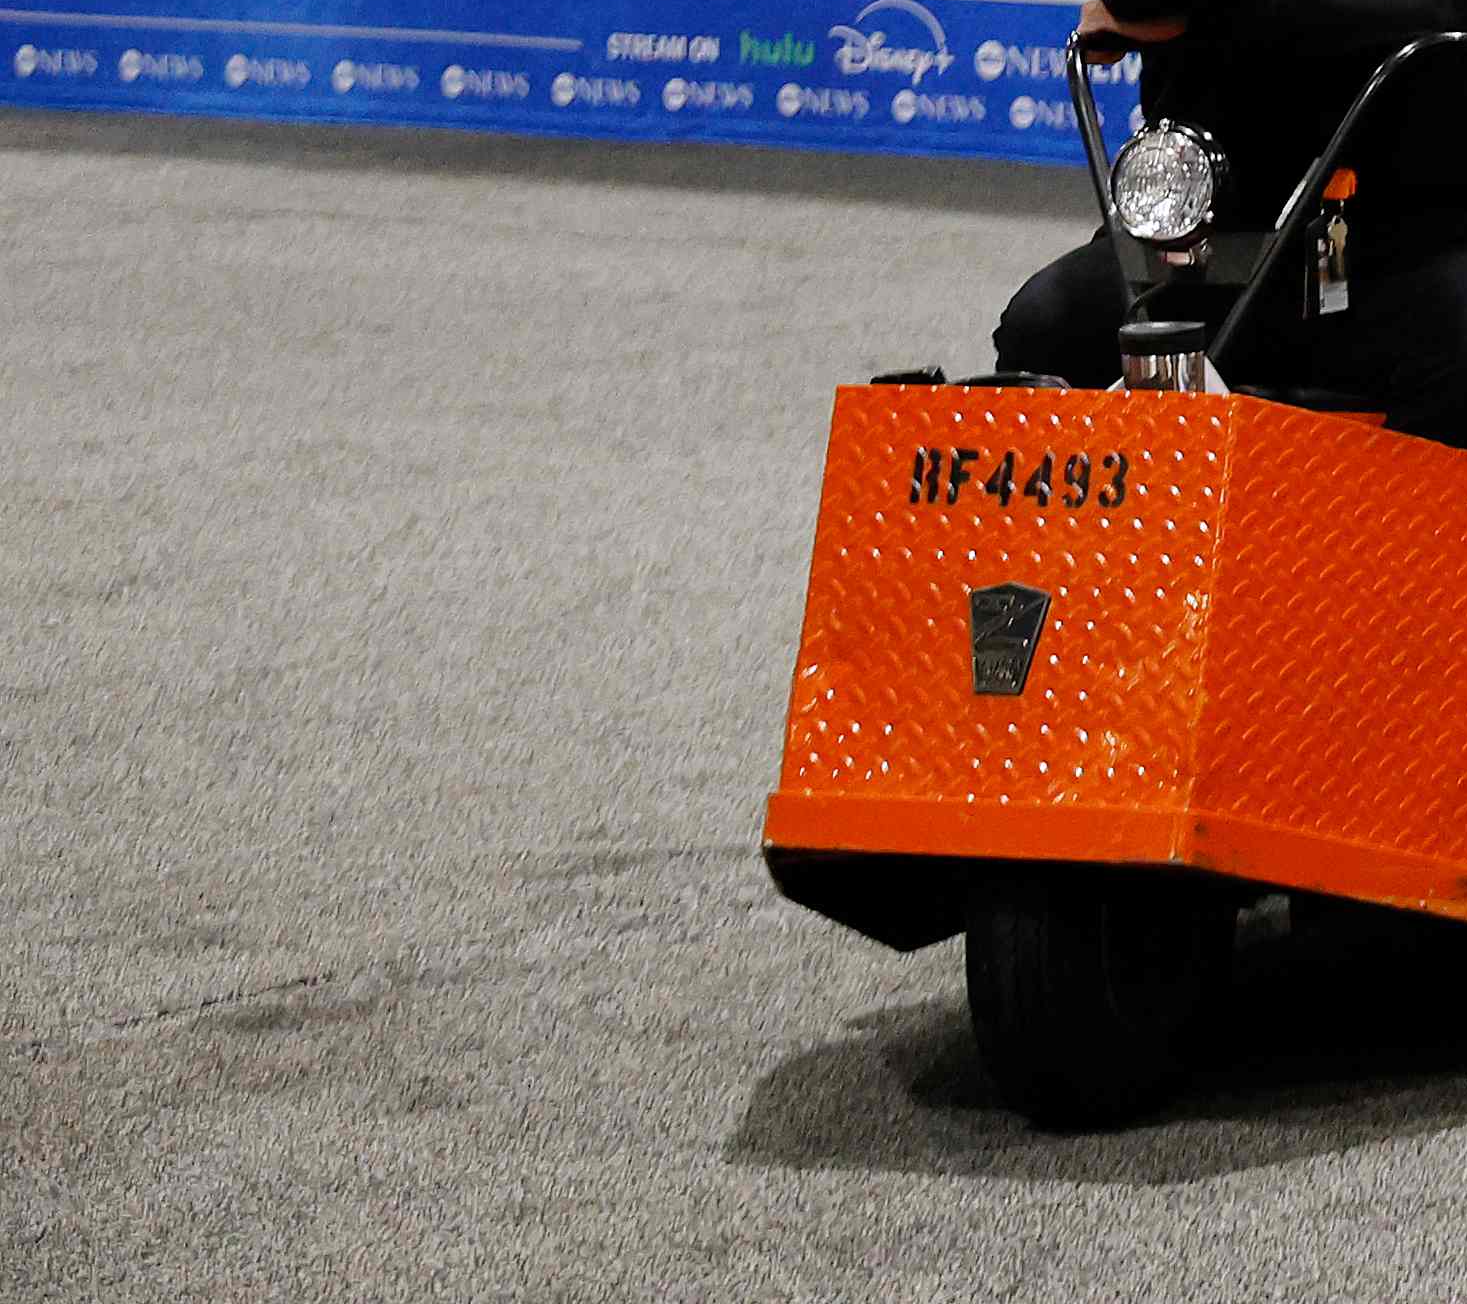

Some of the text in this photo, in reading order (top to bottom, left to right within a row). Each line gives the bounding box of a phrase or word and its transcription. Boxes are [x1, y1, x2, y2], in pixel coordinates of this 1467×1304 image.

[606, 32, 721, 65] STREAM ON
[739, 28, 816, 69] hulu
[1006, 44, 1069, 79] NEW
[908, 446, 1132, 510] RF4493
